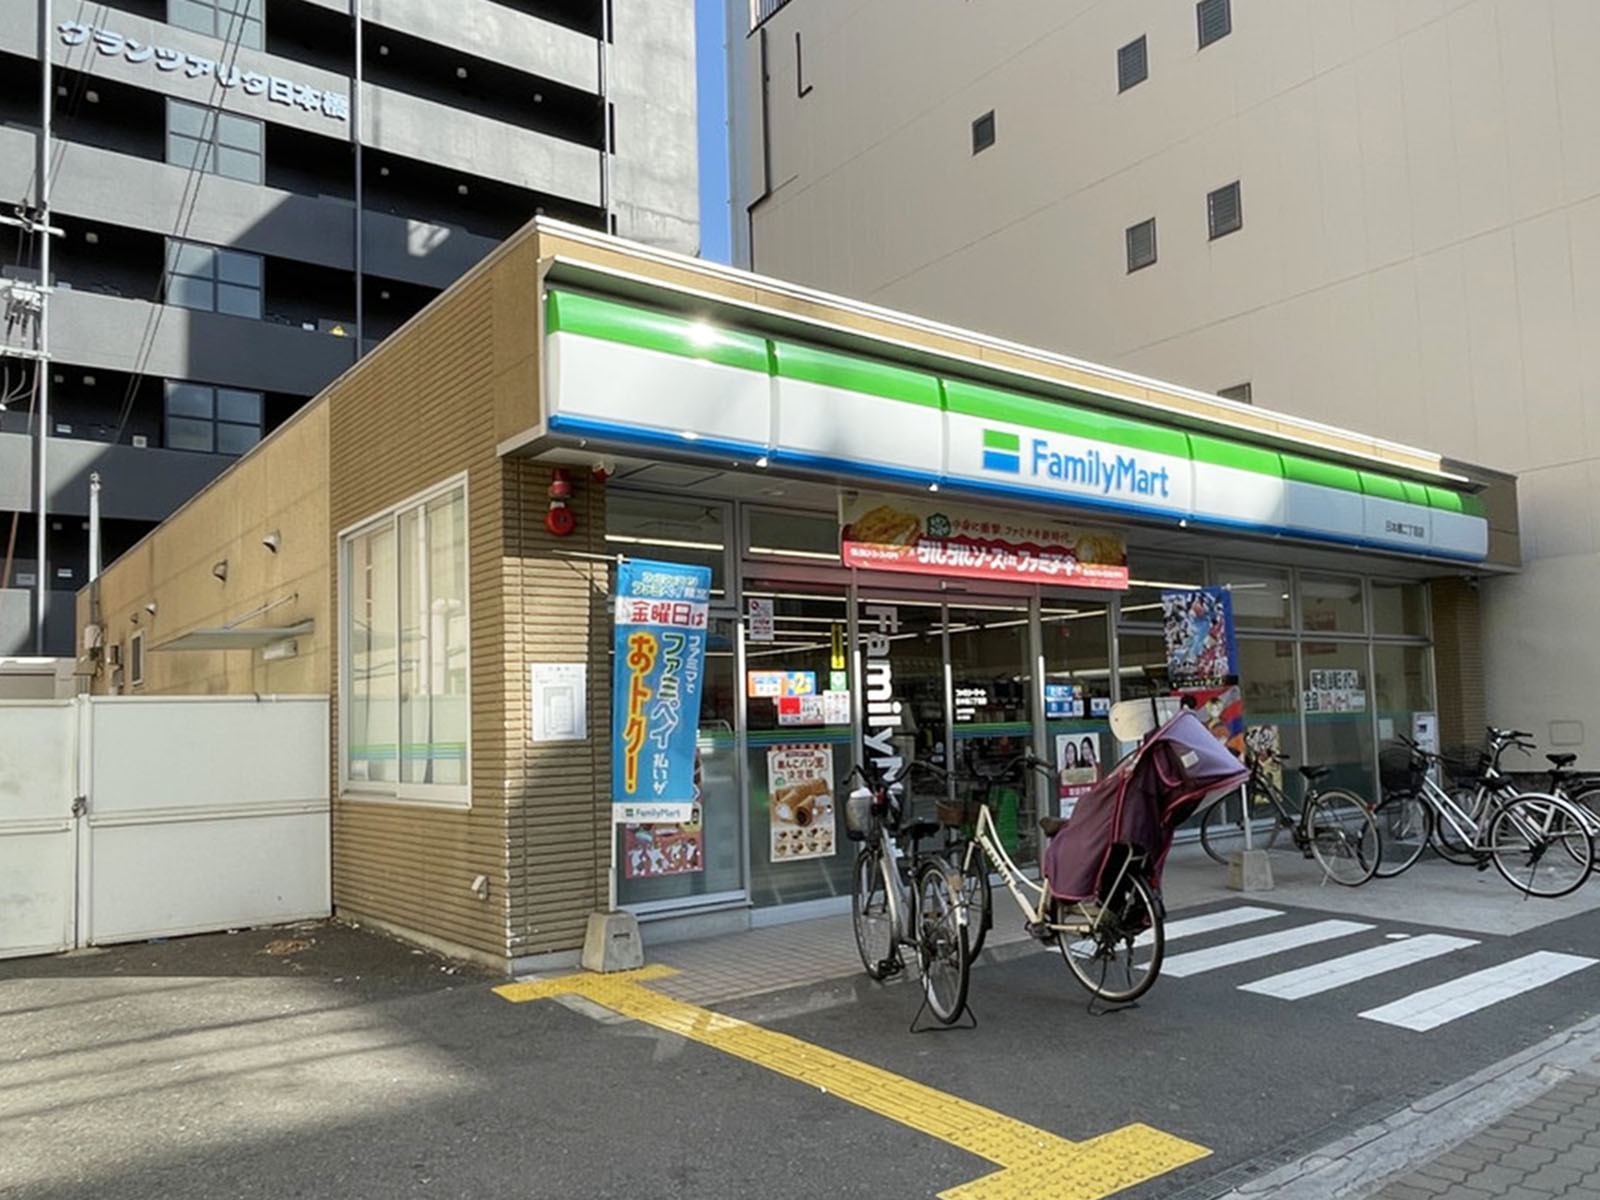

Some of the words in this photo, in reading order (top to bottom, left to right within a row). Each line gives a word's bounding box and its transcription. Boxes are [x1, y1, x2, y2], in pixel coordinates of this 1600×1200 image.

[1032, 438, 1169, 498] FamilyMart
[631, 601, 705, 626] 金曜日は
[635, 807, 681, 818] FamilyMart
